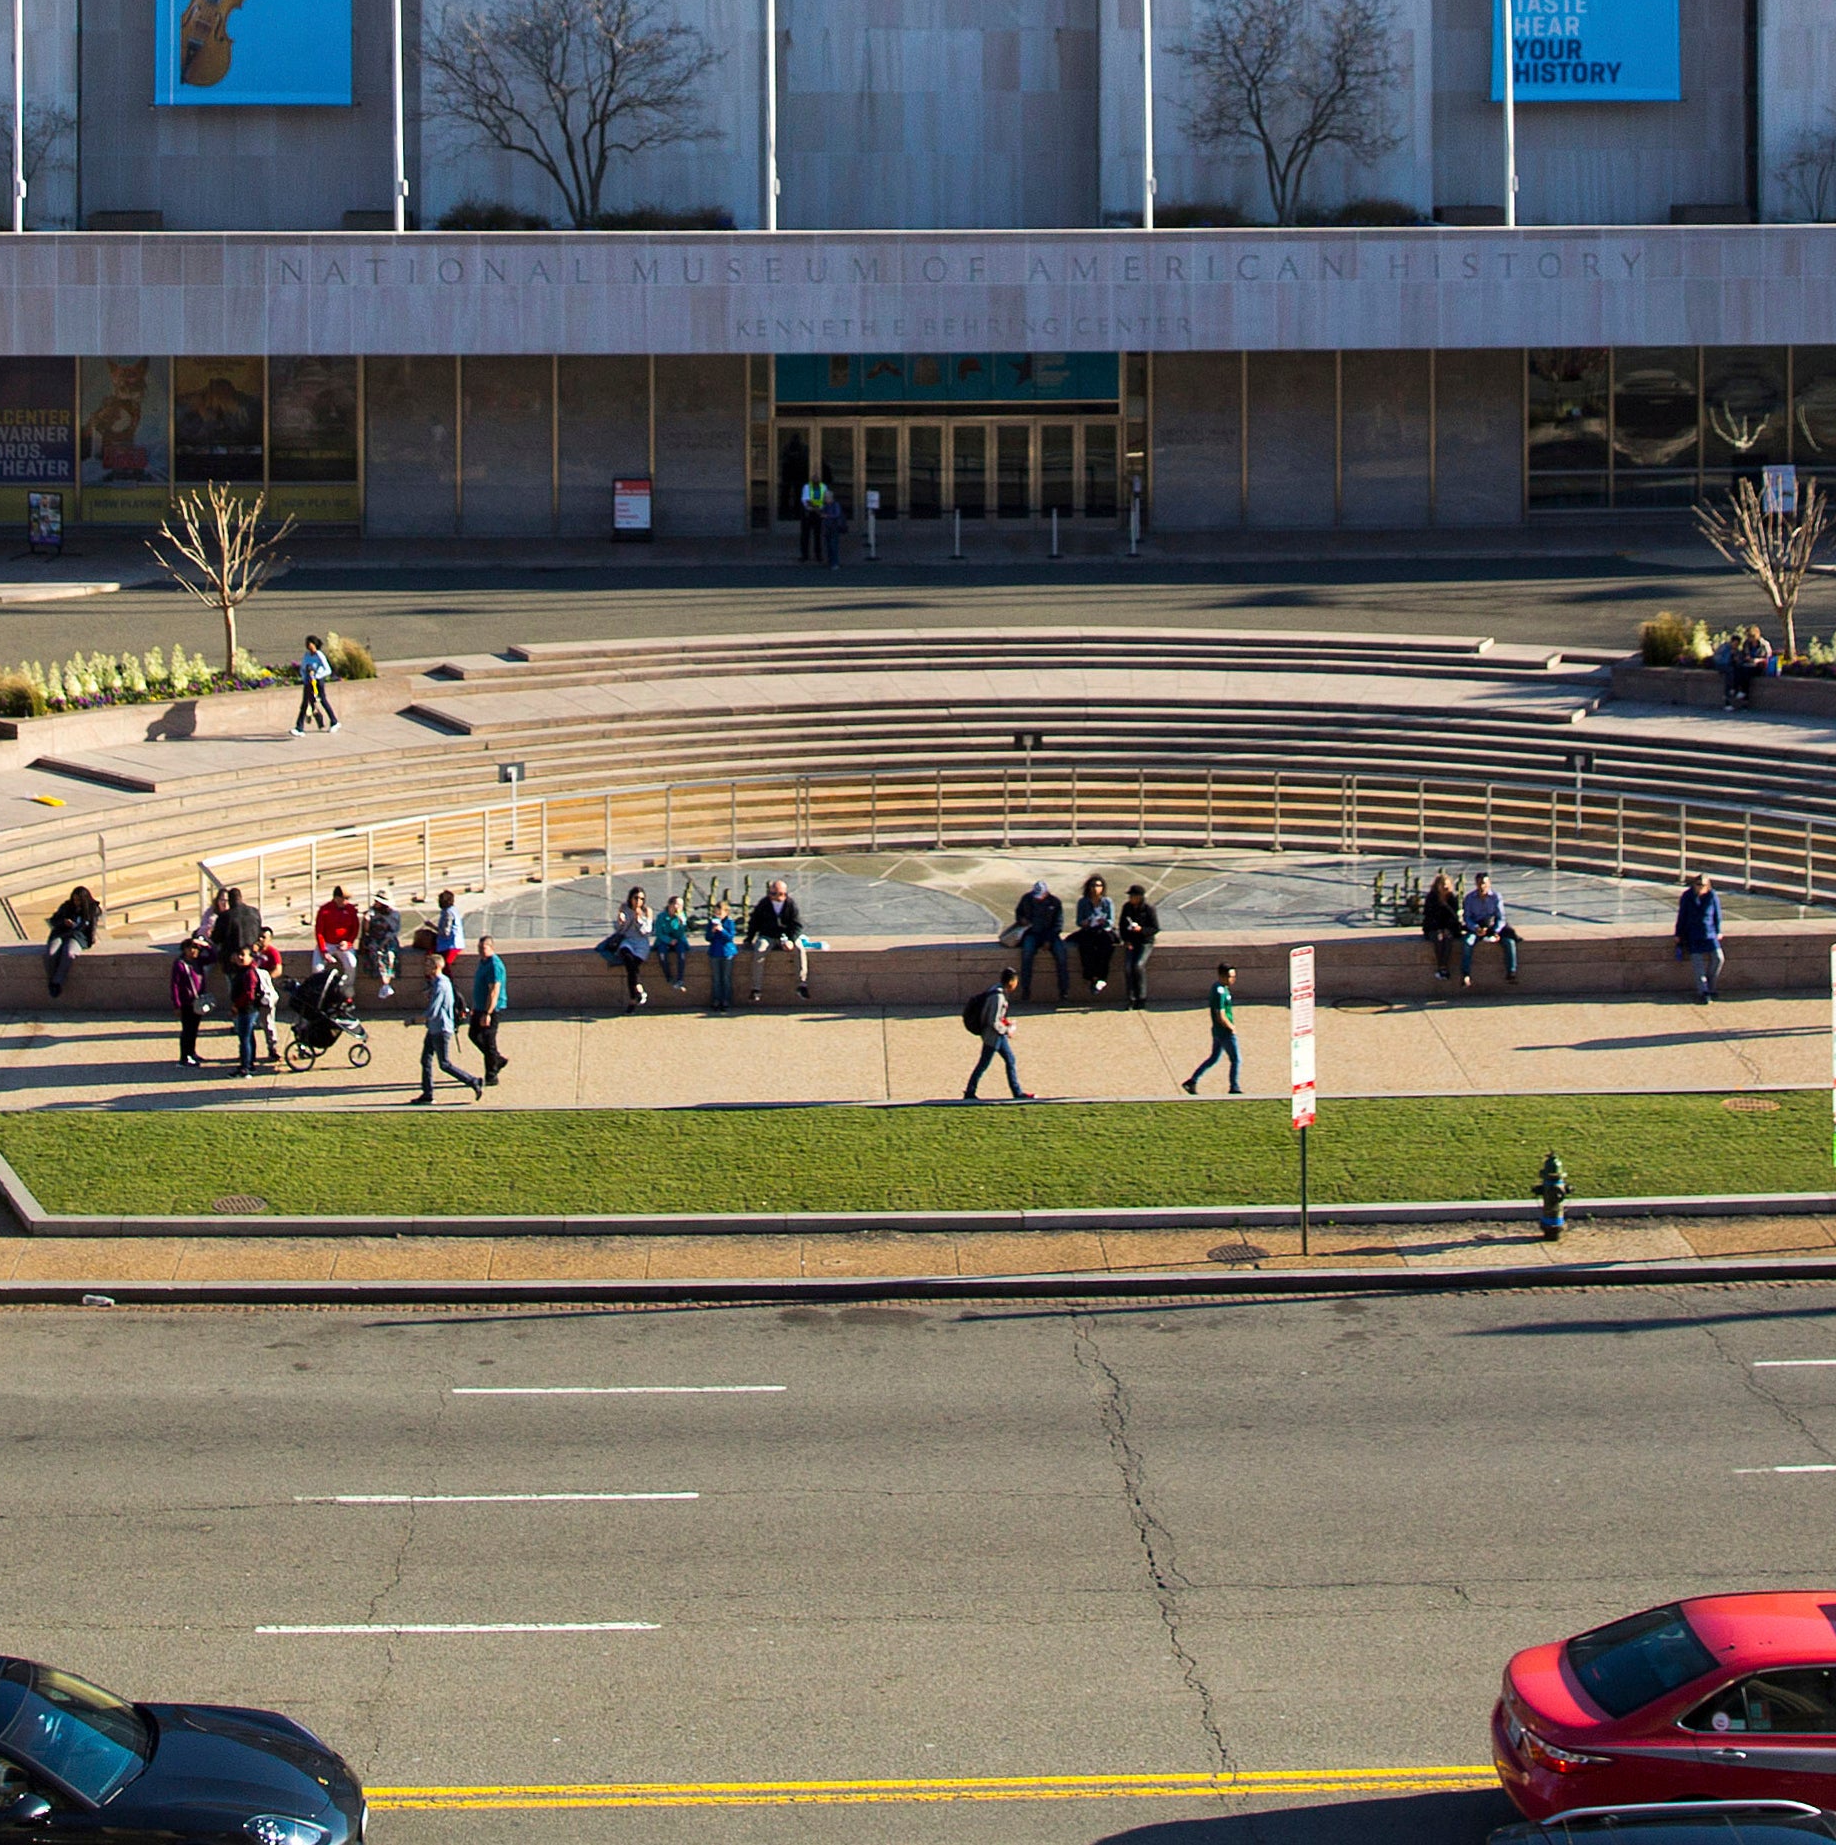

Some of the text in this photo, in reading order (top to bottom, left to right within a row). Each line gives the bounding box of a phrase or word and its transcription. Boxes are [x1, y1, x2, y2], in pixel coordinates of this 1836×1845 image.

[1514, 16, 1580, 36] HEAR
[1514, 39, 1582, 60] YOUR
[1514, 62, 1622, 83] HISTORY
[280, 252, 1645, 284] NATIONAL MUSEUM OF AMERICAN HISTORY
[736, 319, 877, 337] KENNETH
[923, 318, 1060, 336] BEHRING
[1075, 317, 1192, 335] CENTER
